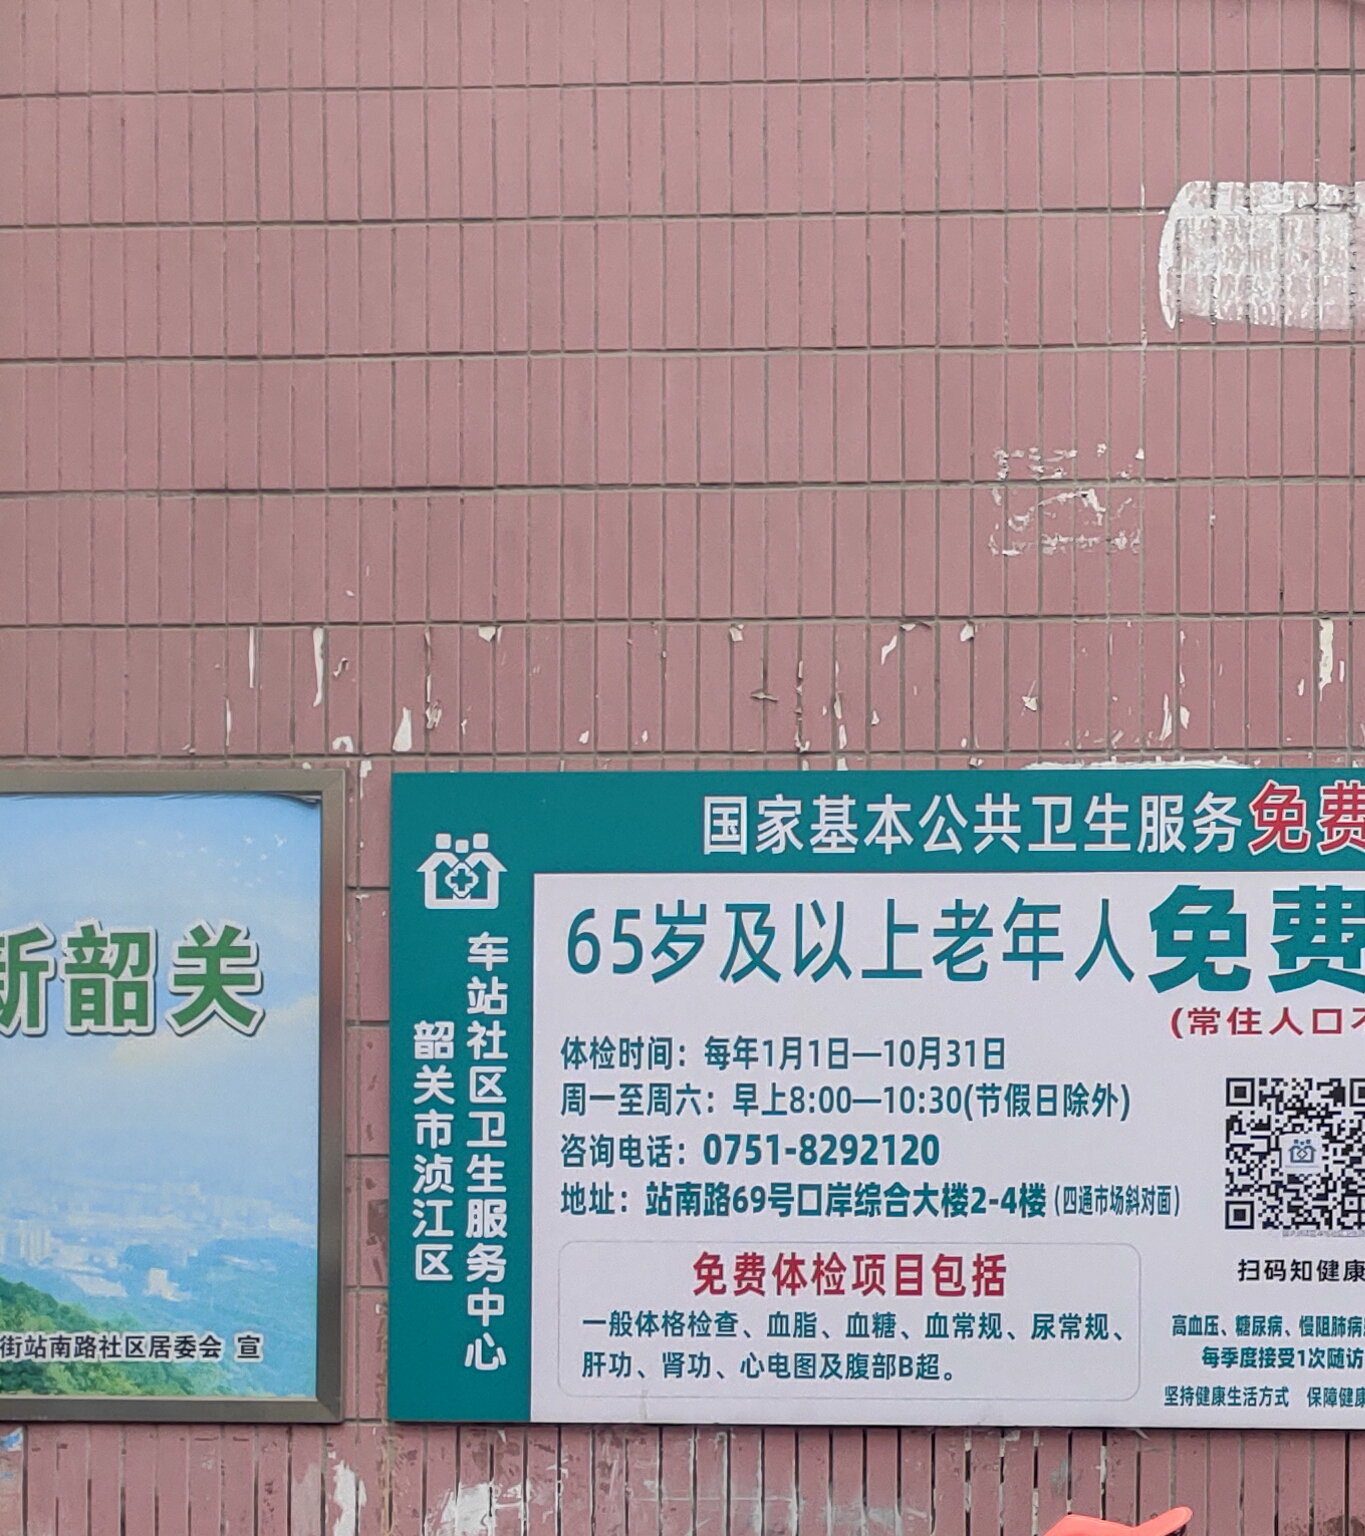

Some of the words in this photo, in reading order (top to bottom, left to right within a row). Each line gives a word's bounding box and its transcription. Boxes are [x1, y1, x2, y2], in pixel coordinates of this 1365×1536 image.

[413, 1020, 455, 1282] 韶关市浈江区
[466, 931, 509, 1371] 车站社区卫生服务中心
[692, 1250, 1008, 1298] 免费体检项目包括
[236, 1335, 262, 1359] 宣
[1201, 1345, 1364, 1370] 每季度接受1次随访
[1164, 1385, 1290, 1408] 坚持健康生活方式
